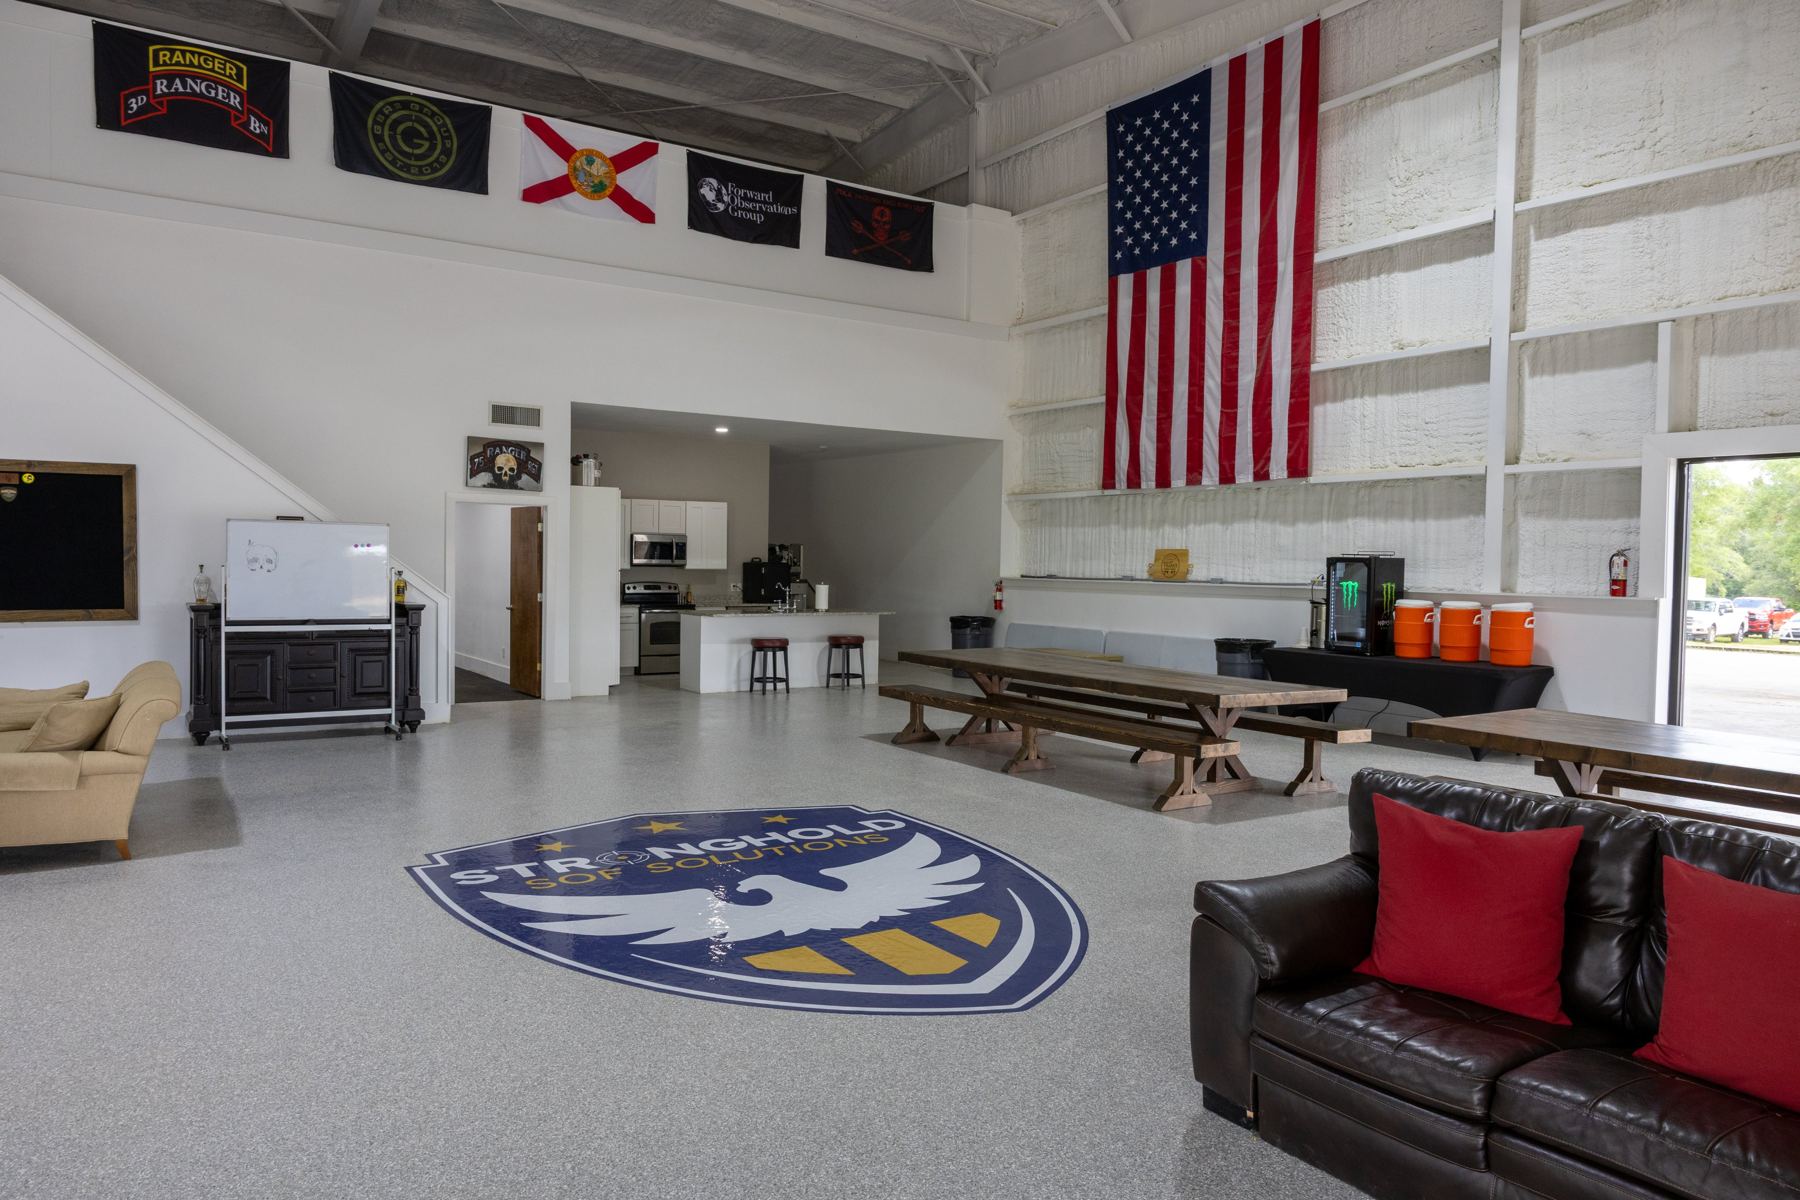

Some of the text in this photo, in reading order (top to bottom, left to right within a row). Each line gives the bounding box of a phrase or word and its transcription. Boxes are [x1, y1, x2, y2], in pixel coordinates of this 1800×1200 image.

[159, 50, 238, 80] RANGER
[127, 95, 147, 114] 3D
[155, 77, 242, 111] RANGER
[410, 103, 451, 148] GROUP
[728, 182, 773, 202] Forward
[728, 194, 798, 215] Observations
[728, 206, 765, 224] Group
[487, 445, 527, 460] RANGER
[450, 819, 906, 885] STRONGHOLD
[526, 833, 889, 890] SOF SOLUTIONS
